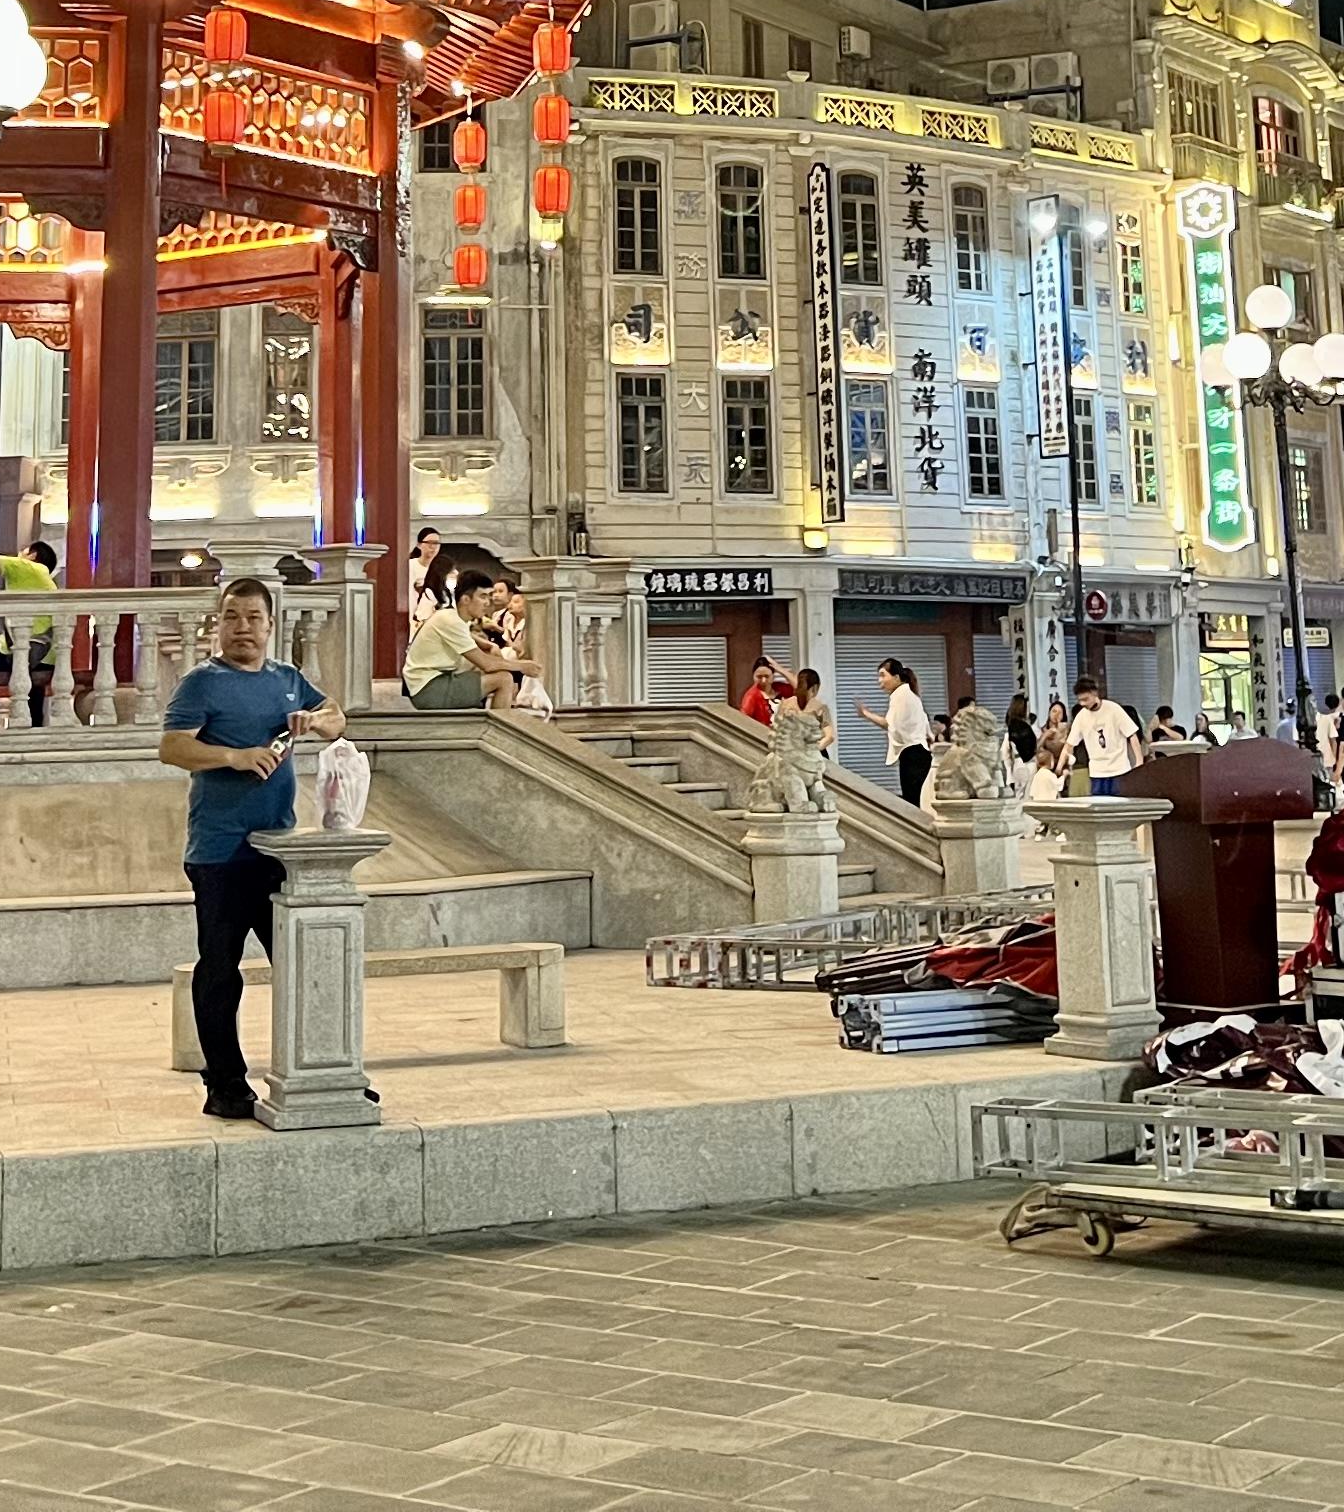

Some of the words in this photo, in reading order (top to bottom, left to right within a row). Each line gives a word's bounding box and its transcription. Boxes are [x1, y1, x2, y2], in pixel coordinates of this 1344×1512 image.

[901, 162, 933, 306] 英美罐頭
[912, 348, 945, 491] 南洋北貨
